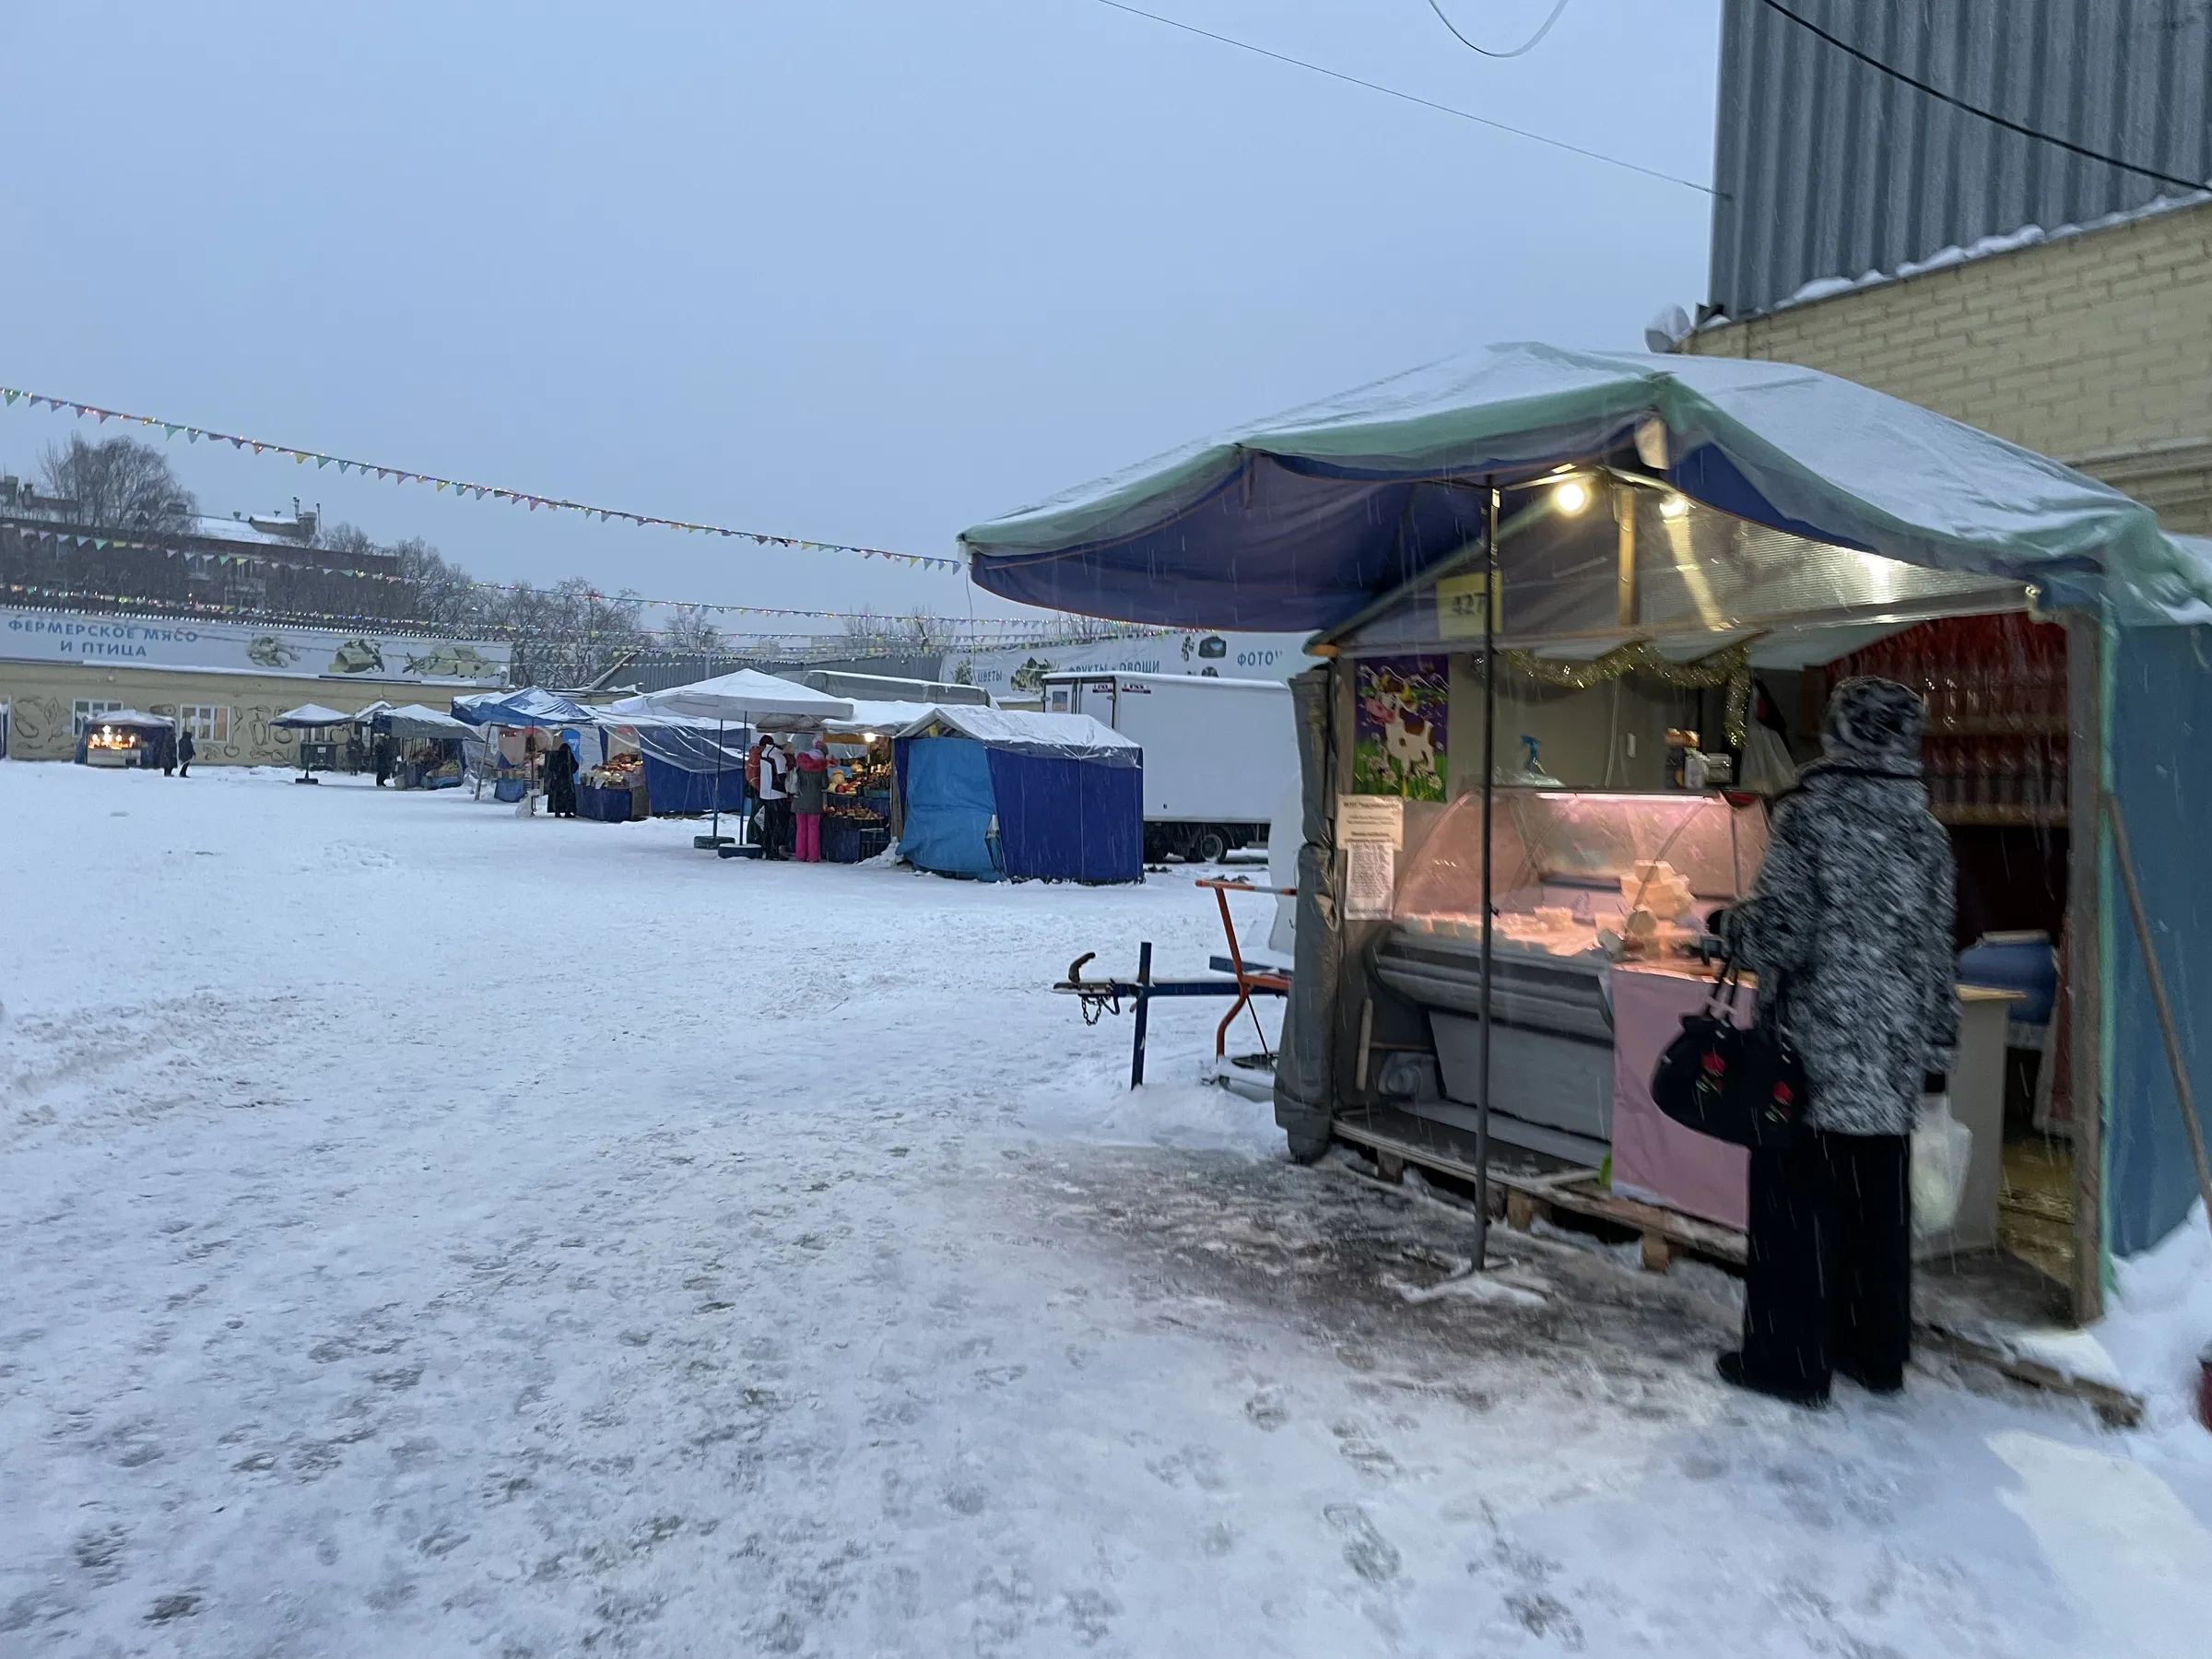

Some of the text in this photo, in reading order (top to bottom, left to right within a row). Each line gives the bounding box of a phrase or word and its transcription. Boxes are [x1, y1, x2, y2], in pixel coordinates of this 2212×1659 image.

[8, 618, 197, 642] ФЕРМЕРСКОЕ МЯСО
[60, 640, 147, 657] И ПТИЦА
[1119, 660, 1159, 674] ОВОЩИ
[977, 669, 1003, 683] ЦВЕТЫ
